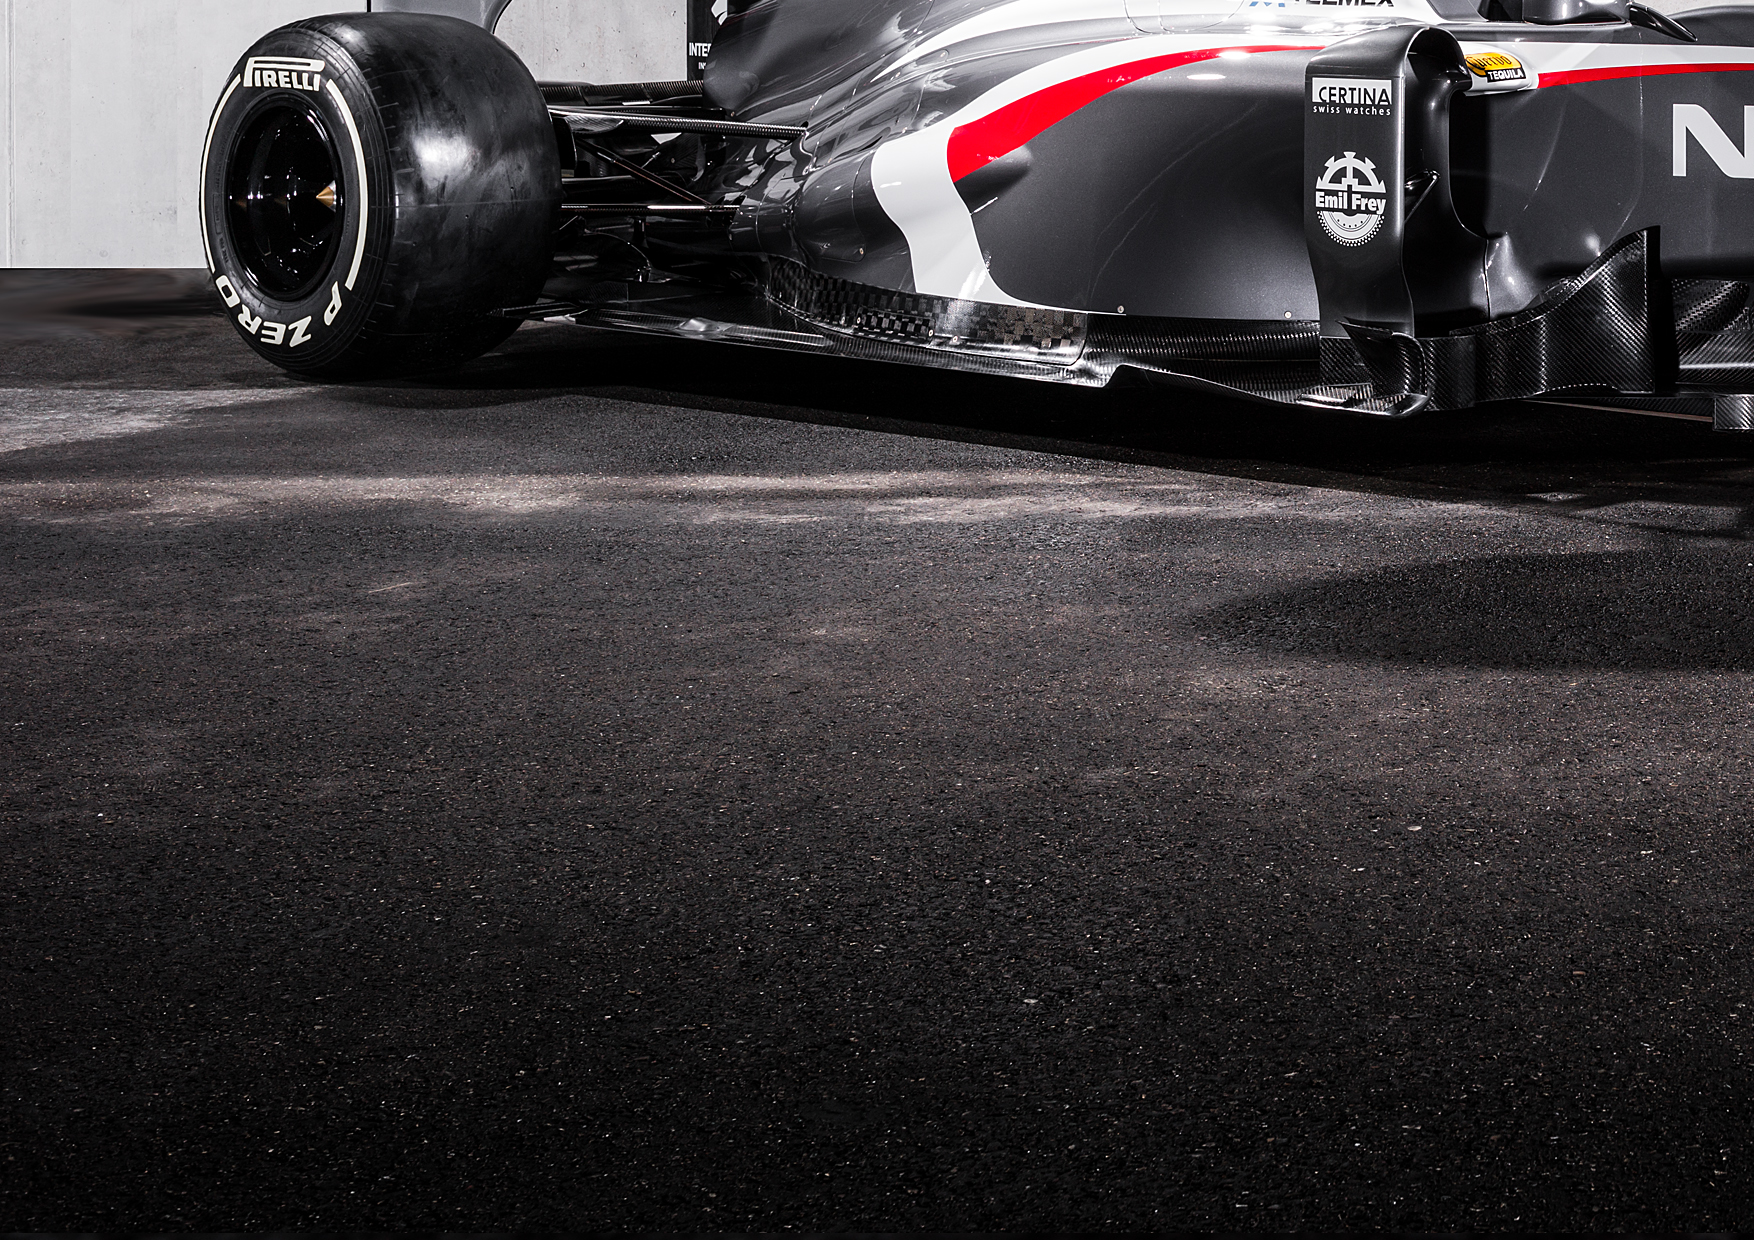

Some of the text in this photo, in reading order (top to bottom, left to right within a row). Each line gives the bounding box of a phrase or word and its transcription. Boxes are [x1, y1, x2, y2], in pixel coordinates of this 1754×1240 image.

[243, 56, 326, 92] PIRELLI
[1487, 68, 1525, 80] TEQUILA
[1318, 85, 1392, 105] CERTINA
[1313, 104, 1392, 116] swiss watches
[1315, 191, 1387, 215] Emil Frey
[215, 274, 344, 348] P ZERO
